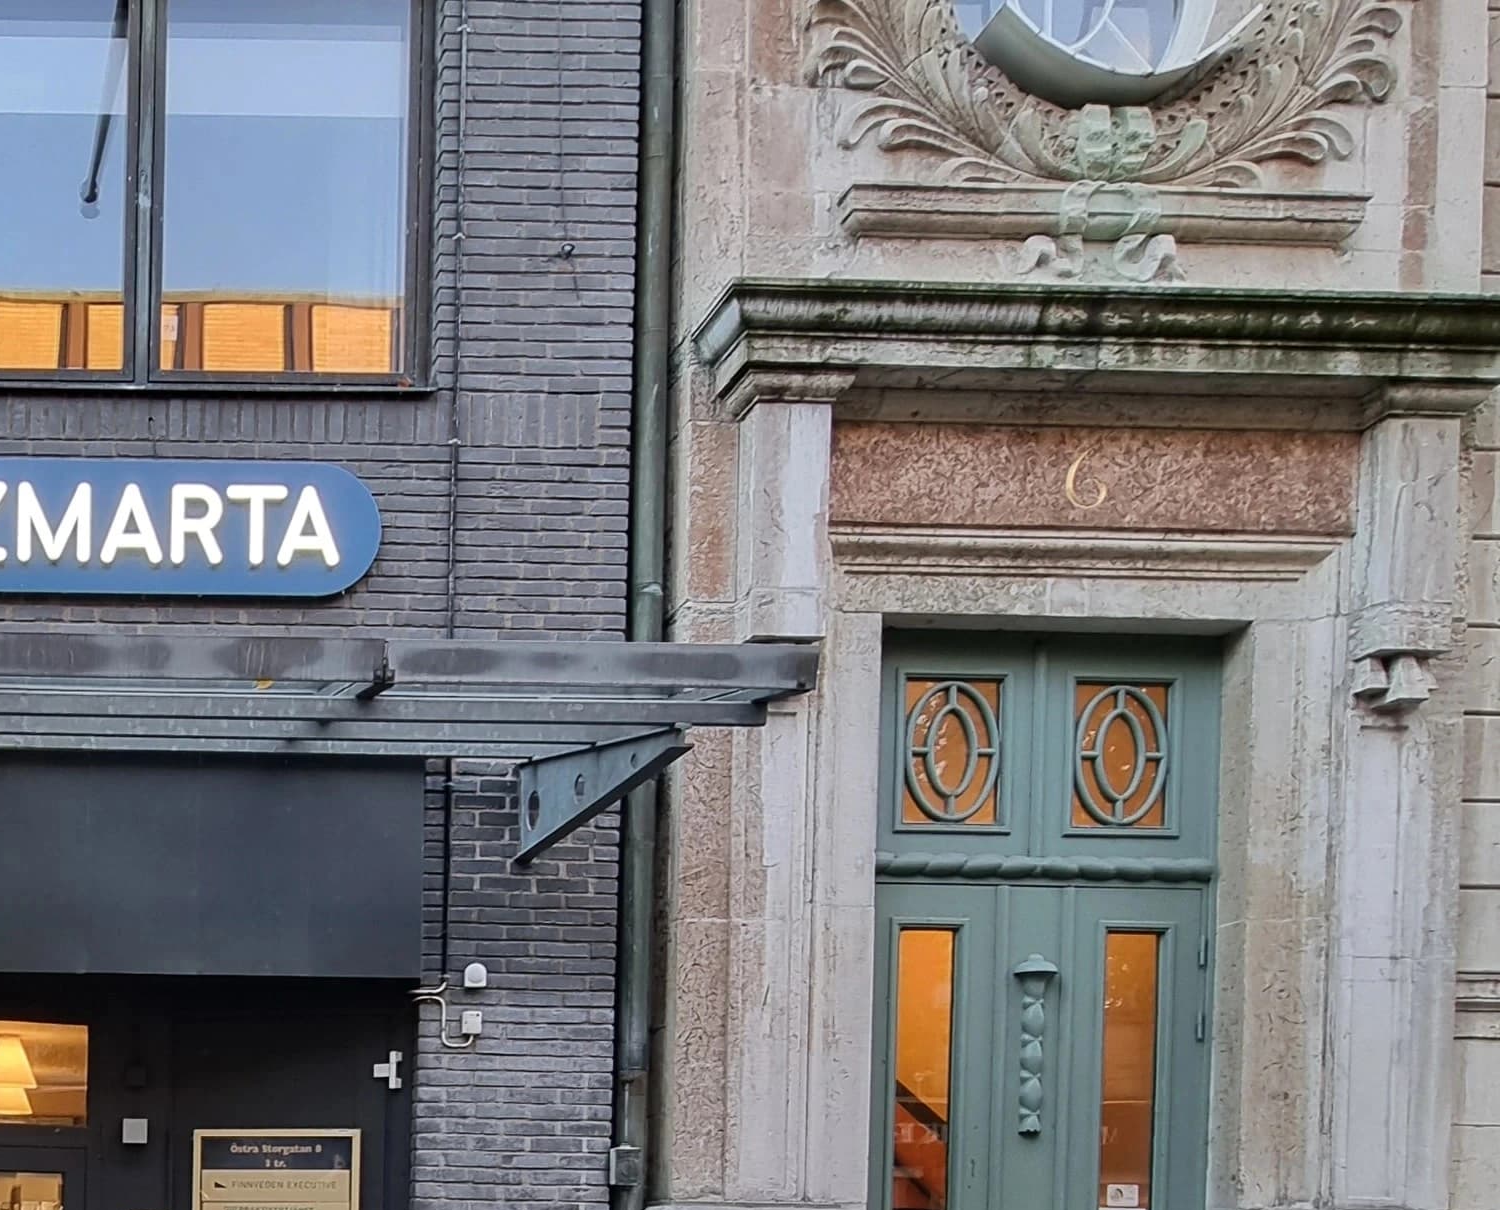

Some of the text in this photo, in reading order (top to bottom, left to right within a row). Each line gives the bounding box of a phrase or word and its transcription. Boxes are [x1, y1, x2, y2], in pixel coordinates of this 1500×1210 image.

[1066, 448, 1107, 508] 6
[230, 1142, 259, 1154] Östra
[262, 1144, 312, 1156] Storgatan
